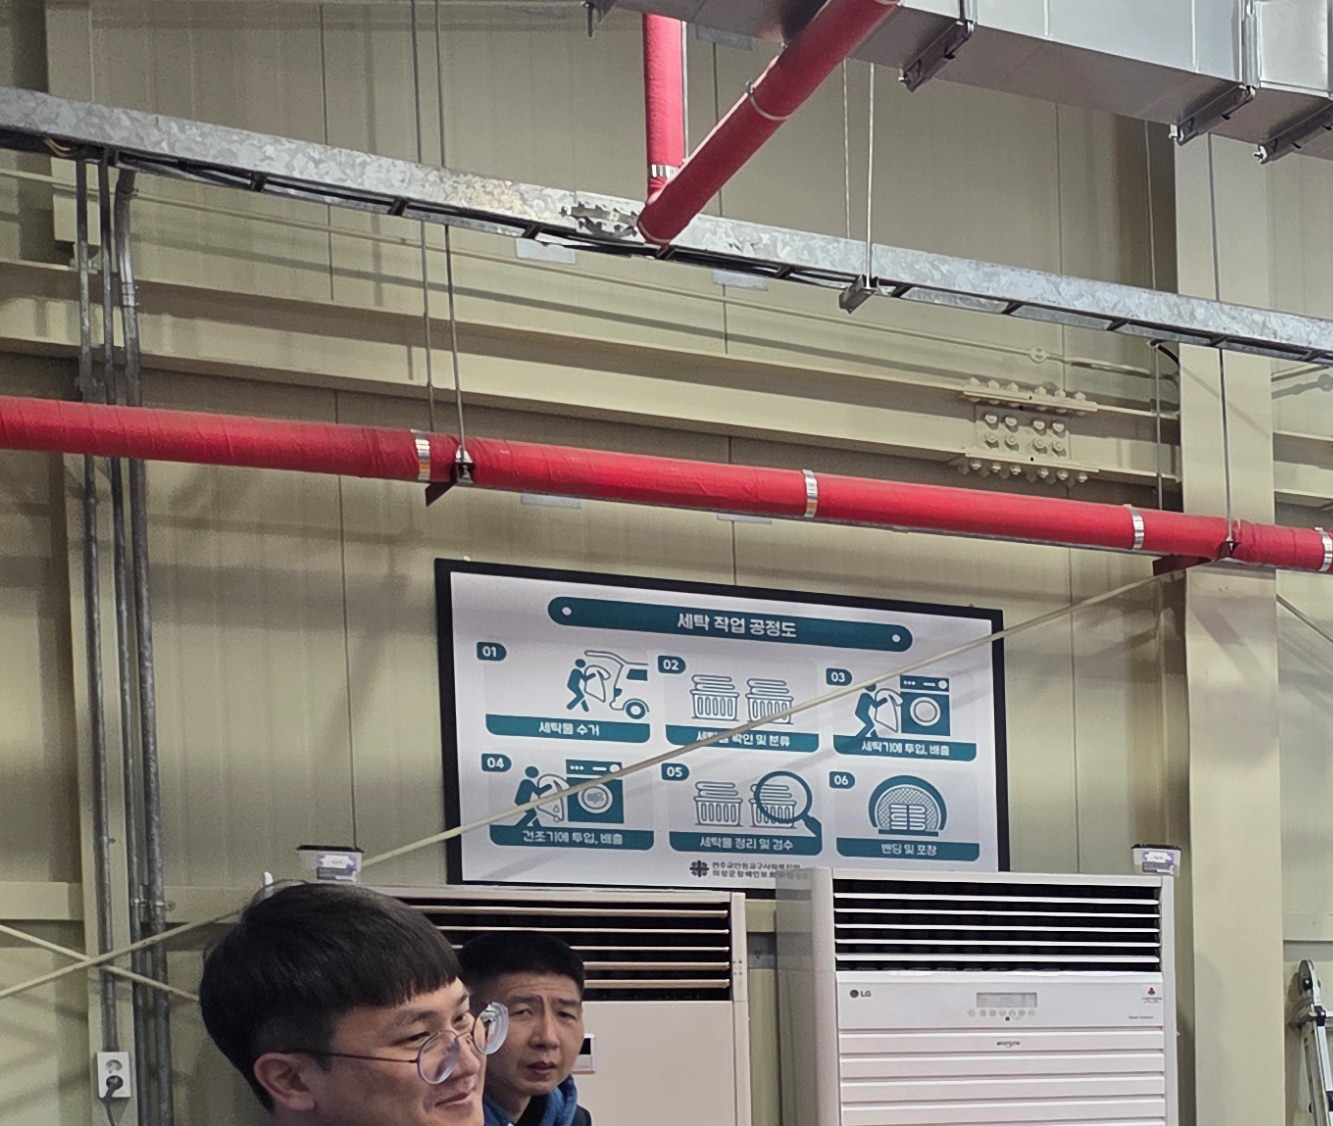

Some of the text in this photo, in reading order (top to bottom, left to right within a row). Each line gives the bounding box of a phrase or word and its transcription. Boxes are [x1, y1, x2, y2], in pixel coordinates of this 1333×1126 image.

[677, 613, 797, 638] 세탁 작업 공정도
[482, 646, 497, 658] 01
[663, 659, 679, 671] 02
[830, 672, 846, 683] 03
[538, 721, 600, 737] 세탁물 수거
[755, 734, 767, 746] 및
[769, 735, 790, 747] 분류
[861, 740, 950, 757] 세탁기에 투입, 배출
[486, 757, 504, 768] 04
[666, 767, 683, 777] 05
[833, 775, 849, 786] 06
[522, 830, 623, 845] 건조기에 투입, 배출
[700, 836, 794, 851] 세탁물 정리 및 검수
[904, 843, 915, 855] 및
[916, 844, 937, 857] 포장
